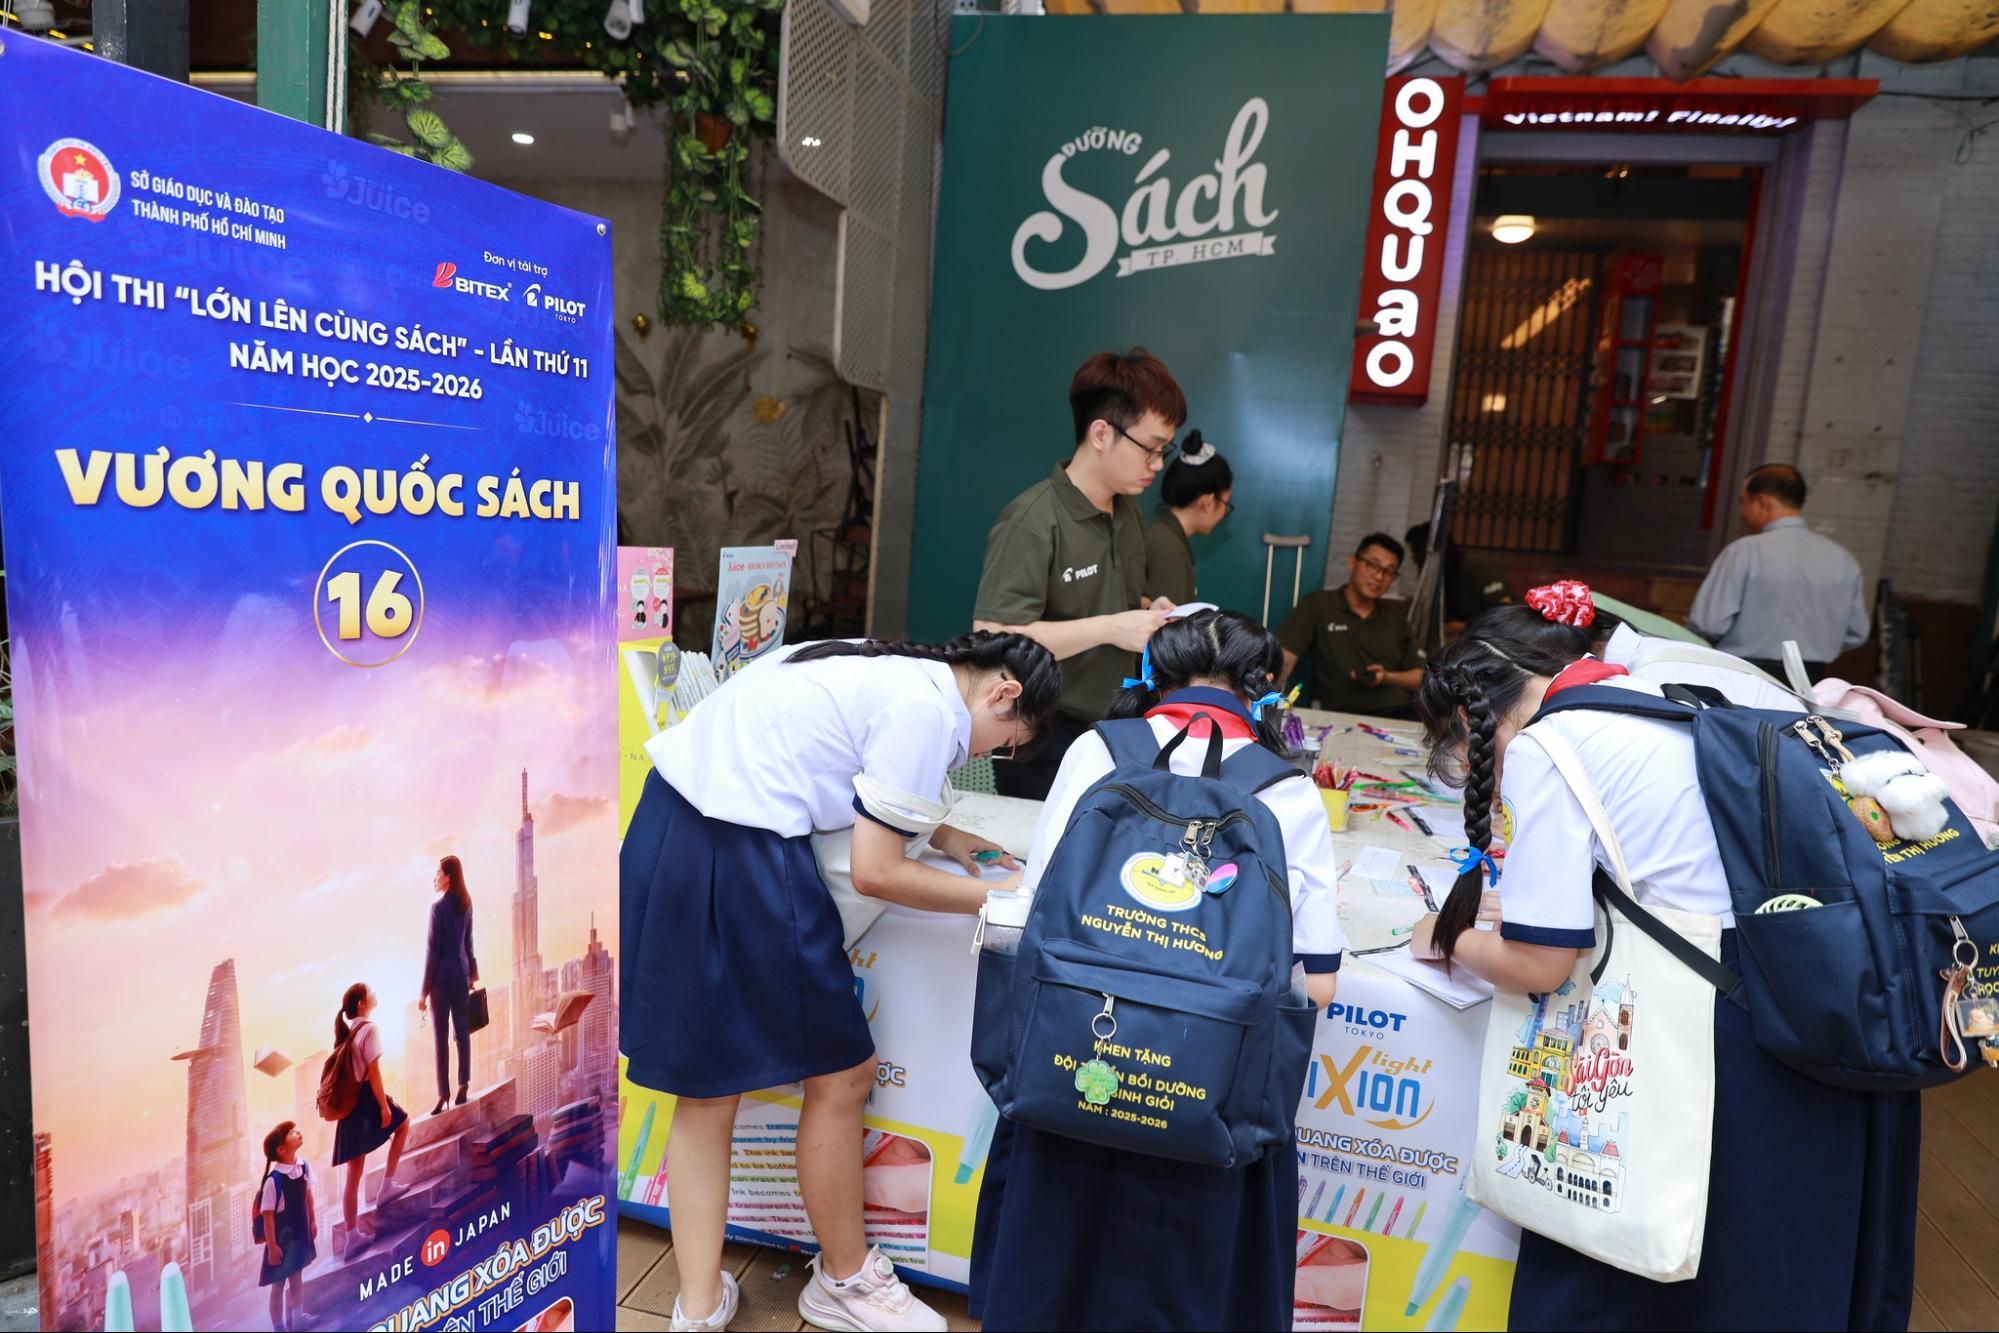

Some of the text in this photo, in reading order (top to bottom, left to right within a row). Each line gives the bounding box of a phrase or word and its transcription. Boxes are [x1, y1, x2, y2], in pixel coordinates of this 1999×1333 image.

[1503, 110, 1798, 129] Vietnam! Finally!
[1061, 126, 1143, 157] ĐƯỜNG
[130, 169, 285, 225] SỞ GIÁO DỤC VÀ ĐÀO TẠO
[1011, 97, 1279, 290] Sách
[131, 199, 287, 250] THÀNH PHỐ HỒ CHÍ MINH
[484, 251, 548, 278] Đơn vị tài trợ
[1147, 239, 1245, 267] TP. HCM
[455, 276, 510, 302] BITEX
[35, 259, 102, 306] HỘI
[111, 274, 165, 310] THI
[259, 298, 308, 334] LÊN
[314, 309, 389, 347] CÙNG
[490, 338, 529, 369] LẦN
[533, 350, 571, 376] THỨ
[572, 358, 589, 379] 11
[544, 295, 586, 318] PILOT
[555, 313, 577, 324] TOKYO
[229, 339, 483, 400] NĂM HỌC 2025-2026
[54, 445, 580, 525] VƯƠNG QUỐC SÁCH
[1075, 564, 1098, 580] PILOT
[327, 569, 412, 640] 16
[1081, 914, 1142, 939] NGUYỄN
[1146, 930, 1169, 949] THỊ
[1106, 904, 1167, 929] TRƯỜNG
[1326, 1002, 1407, 1032] PILOT
[1345, 1026, 1384, 1040] TOKYO
[1135, 1049, 1172, 1067] TẶNG
[1371, 1050, 1433, 1074] light
[1054, 1054, 1207, 1100] ĐỘI BỒI DƯỠNG
[1145, 1095, 1174, 1111] GIỎI
[1568, 1079, 1633, 1113] tôi yêu
[1111, 1109, 1168, 1130] 2025-2026
[1311, 1154, 1351, 1174] TRÊN
[1357, 1163, 1391, 1181] THẾ
[1392, 1171, 1425, 1188] GIỚI
[1355, 1138, 1396, 1162] XÓA
[1399, 1146, 1458, 1175] ĐƯỢC
[359, 1201, 511, 1301] MADE in JAPAN
[474, 1240, 529, 1293] XÓA
[530, 1195, 603, 1255] ĐƯỢC
[478, 1270, 524, 1327] THẾ
[526, 1250, 567, 1297] GIỚI
